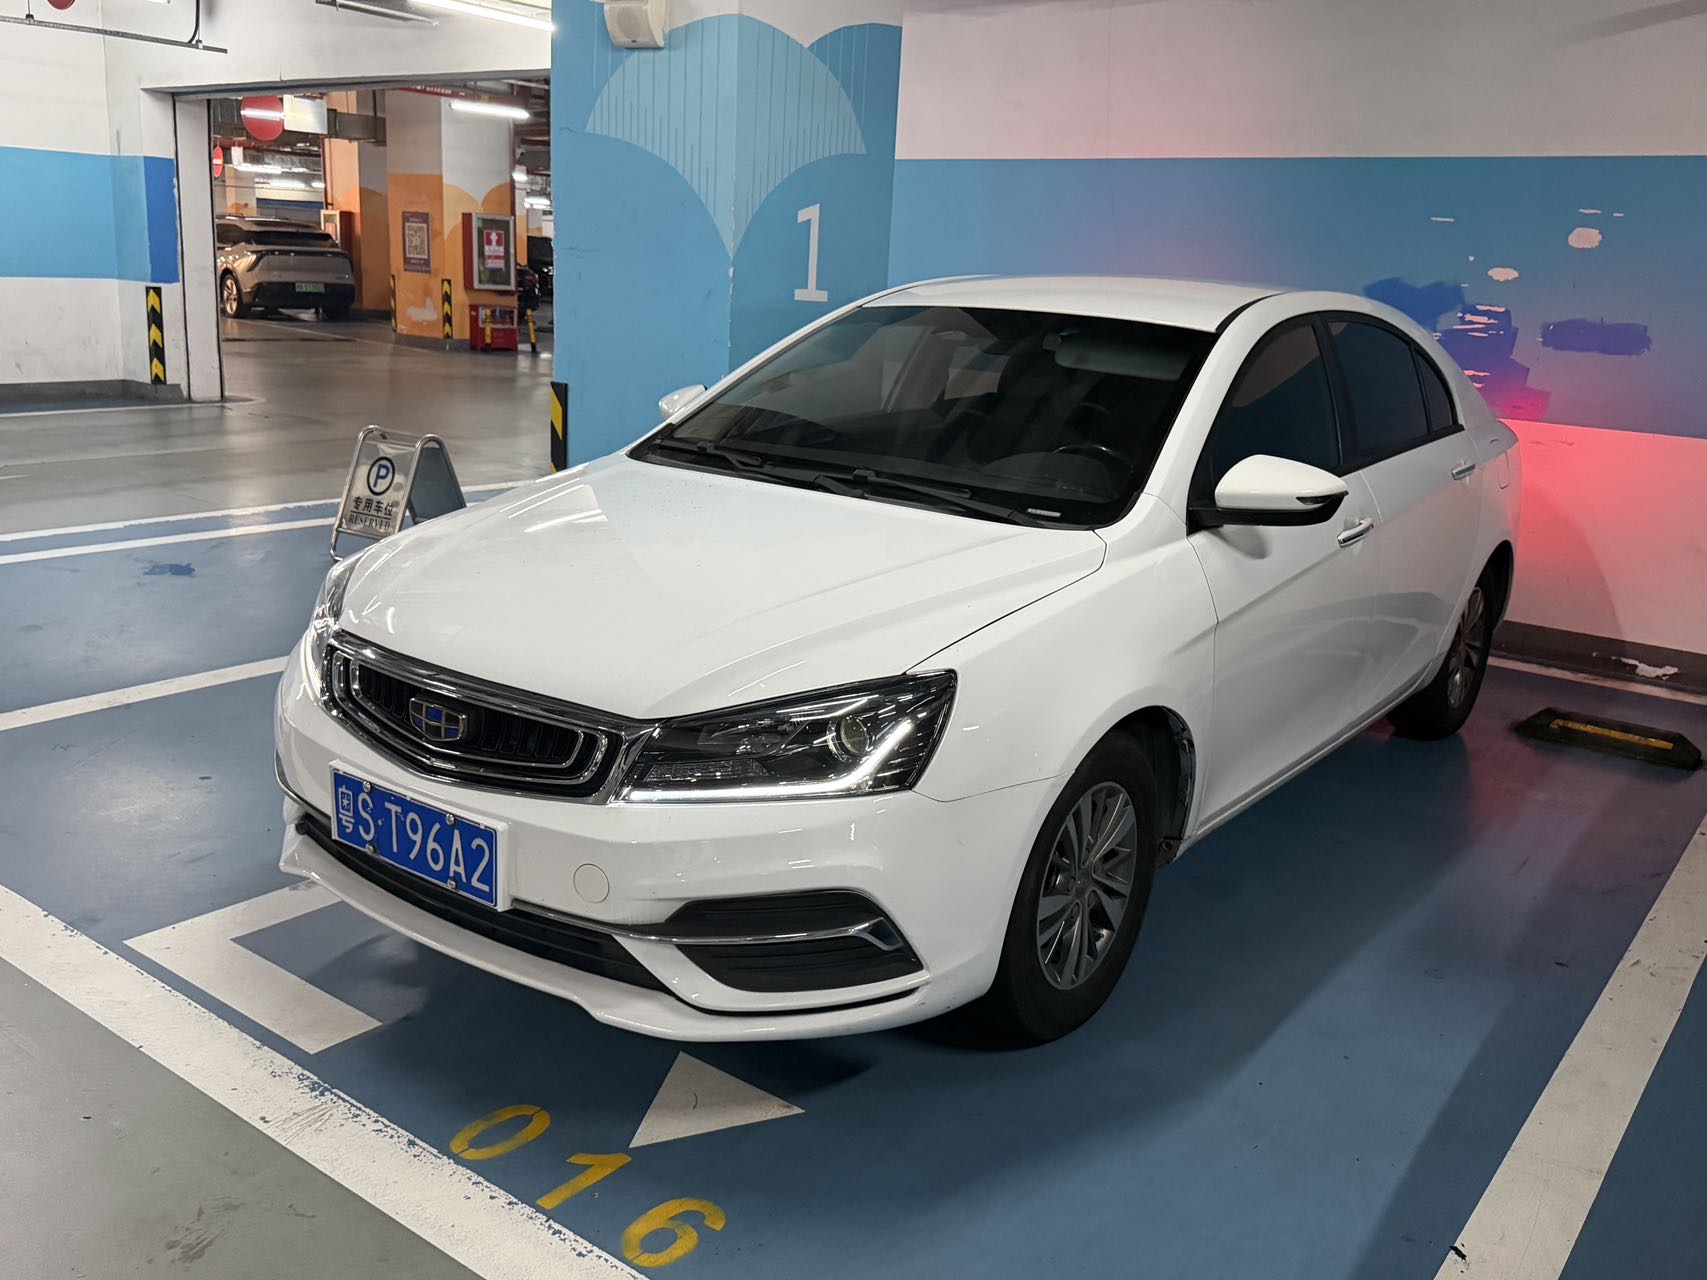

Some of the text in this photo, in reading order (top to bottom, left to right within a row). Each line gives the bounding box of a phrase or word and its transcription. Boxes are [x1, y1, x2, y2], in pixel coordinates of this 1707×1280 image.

[794, 203, 829, 302] 1
[373, 463, 390, 488] P
[352, 496, 395, 516] 专用车位
[348, 514, 391, 531] RESERVED
